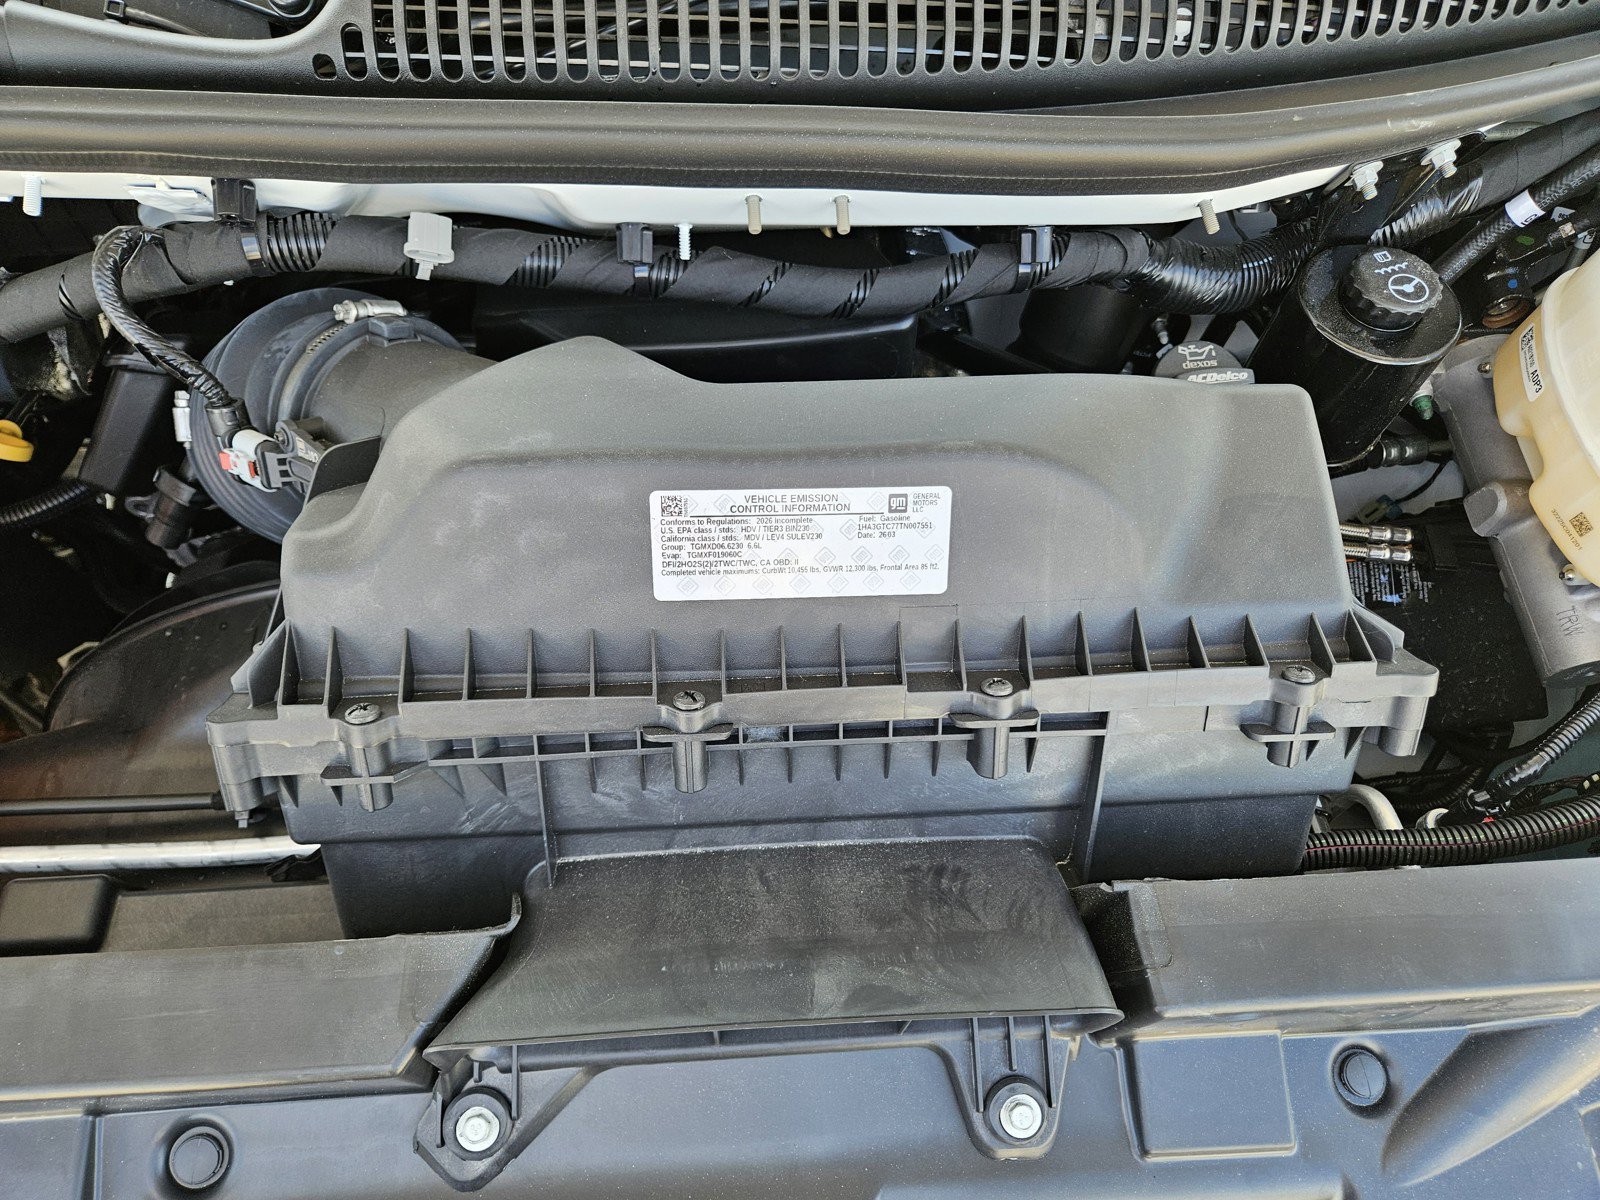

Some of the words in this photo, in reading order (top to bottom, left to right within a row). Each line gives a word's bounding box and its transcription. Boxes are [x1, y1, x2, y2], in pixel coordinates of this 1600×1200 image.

[1182, 360, 1218, 369] dexos
[1530, 369, 1543, 394] ADP3
[744, 494, 788, 503] VEHICLE
[790, 493, 839, 503] EMISSION
[912, 492, 941, 500] GENERAL
[912, 499, 938, 507] MOTORS
[730, 504, 779, 513] CONTROL
[781, 503, 851, 513] INFORMATION
[660, 518, 696, 526] Conforms
[706, 517, 751, 527] Regulations:
[756, 517, 773, 525] 2026
[774, 516, 813, 526] Incomplete
[858, 515, 877, 523] Fuel:
[879, 514, 911, 522] Gasoline
[660, 526, 675, 535] U.S.
[677, 526, 692, 534] EPA
[693, 526, 713, 534] class
[718, 525, 737, 534] stds:
[740, 525, 757, 533] HDV
[762, 524, 784, 533] TIER3
[857, 521, 933, 531] 1HA3GTC77TN007551
[660, 534, 696, 543] California
[696, 534, 716, 542] class
[721, 533, 739, 542] stds:
[743, 533, 761, 541] MDV
[766, 533, 785, 541] LEV4
[786, 532, 823, 541] SULEV230
[857, 531, 876, 539] Date:
[661, 543, 686, 552] Group:
[661, 551, 682, 560] Evap:
[759, 559, 771, 567] CA
[772, 558, 793, 566] OBD:
[661, 569, 697, 577] Completed
[697, 568, 722, 576] vehicle
[822, 565, 844, 573] GVWR
[879, 563, 903, 571] Frontal
[904, 563, 919, 571] Area
